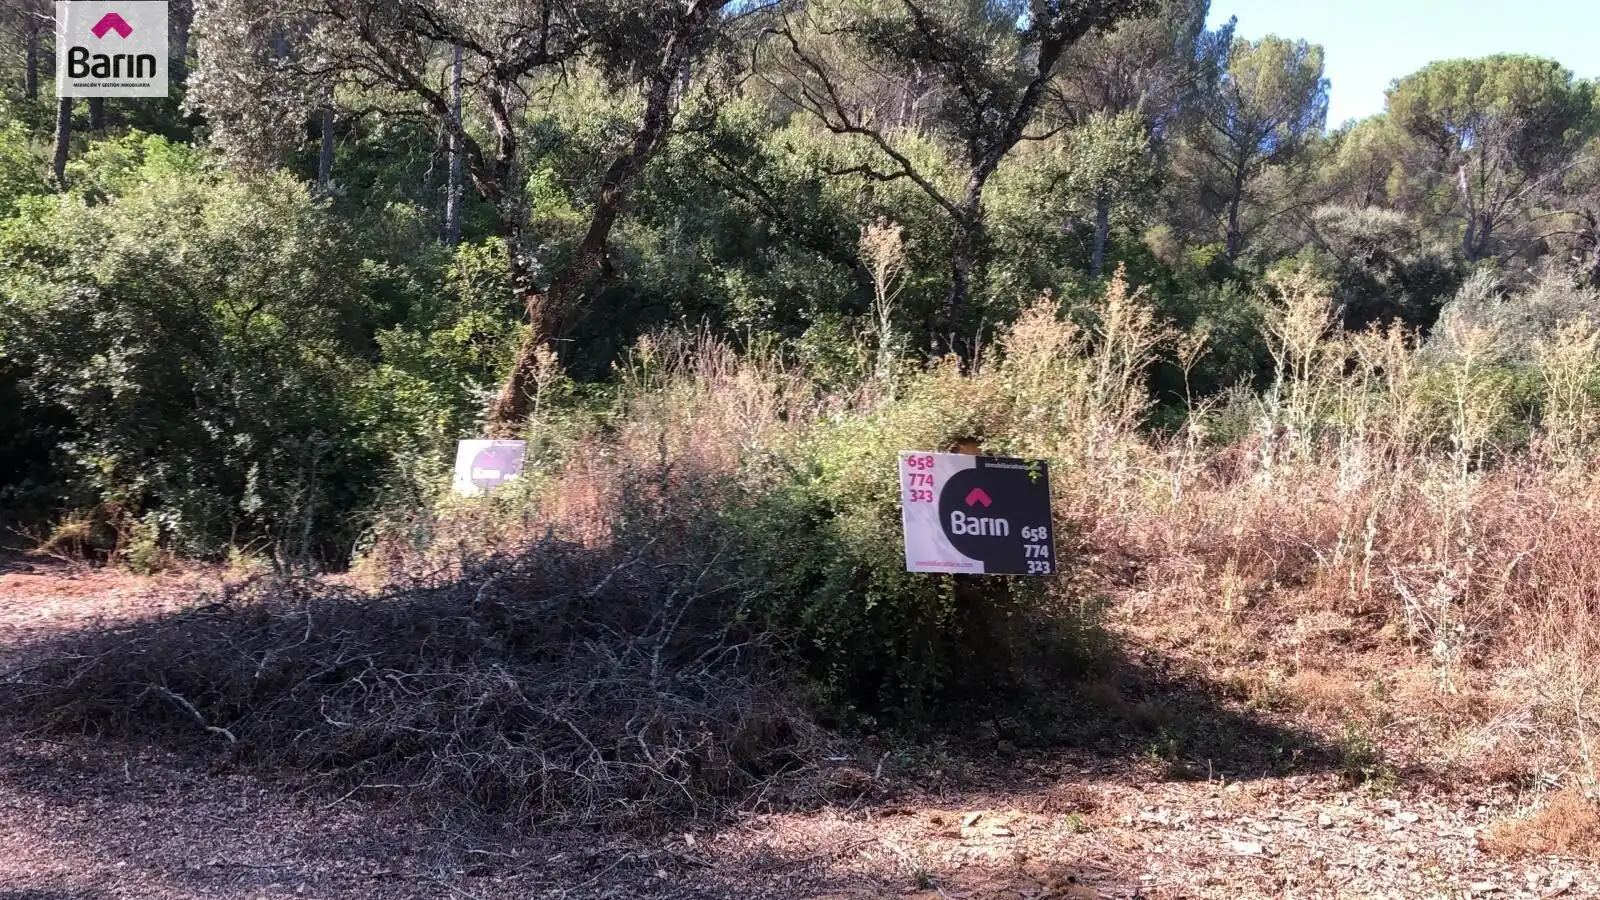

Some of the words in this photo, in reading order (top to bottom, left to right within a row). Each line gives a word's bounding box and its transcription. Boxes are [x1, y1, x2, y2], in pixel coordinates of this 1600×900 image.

[907, 455, 934, 470] 658
[908, 473, 934, 487] 774
[910, 490, 933, 503] 323
[951, 511, 1010, 537] Barin
[1021, 526, 1048, 542] 658
[1024, 545, 1049, 558] 774
[1027, 561, 1050, 574] 323
